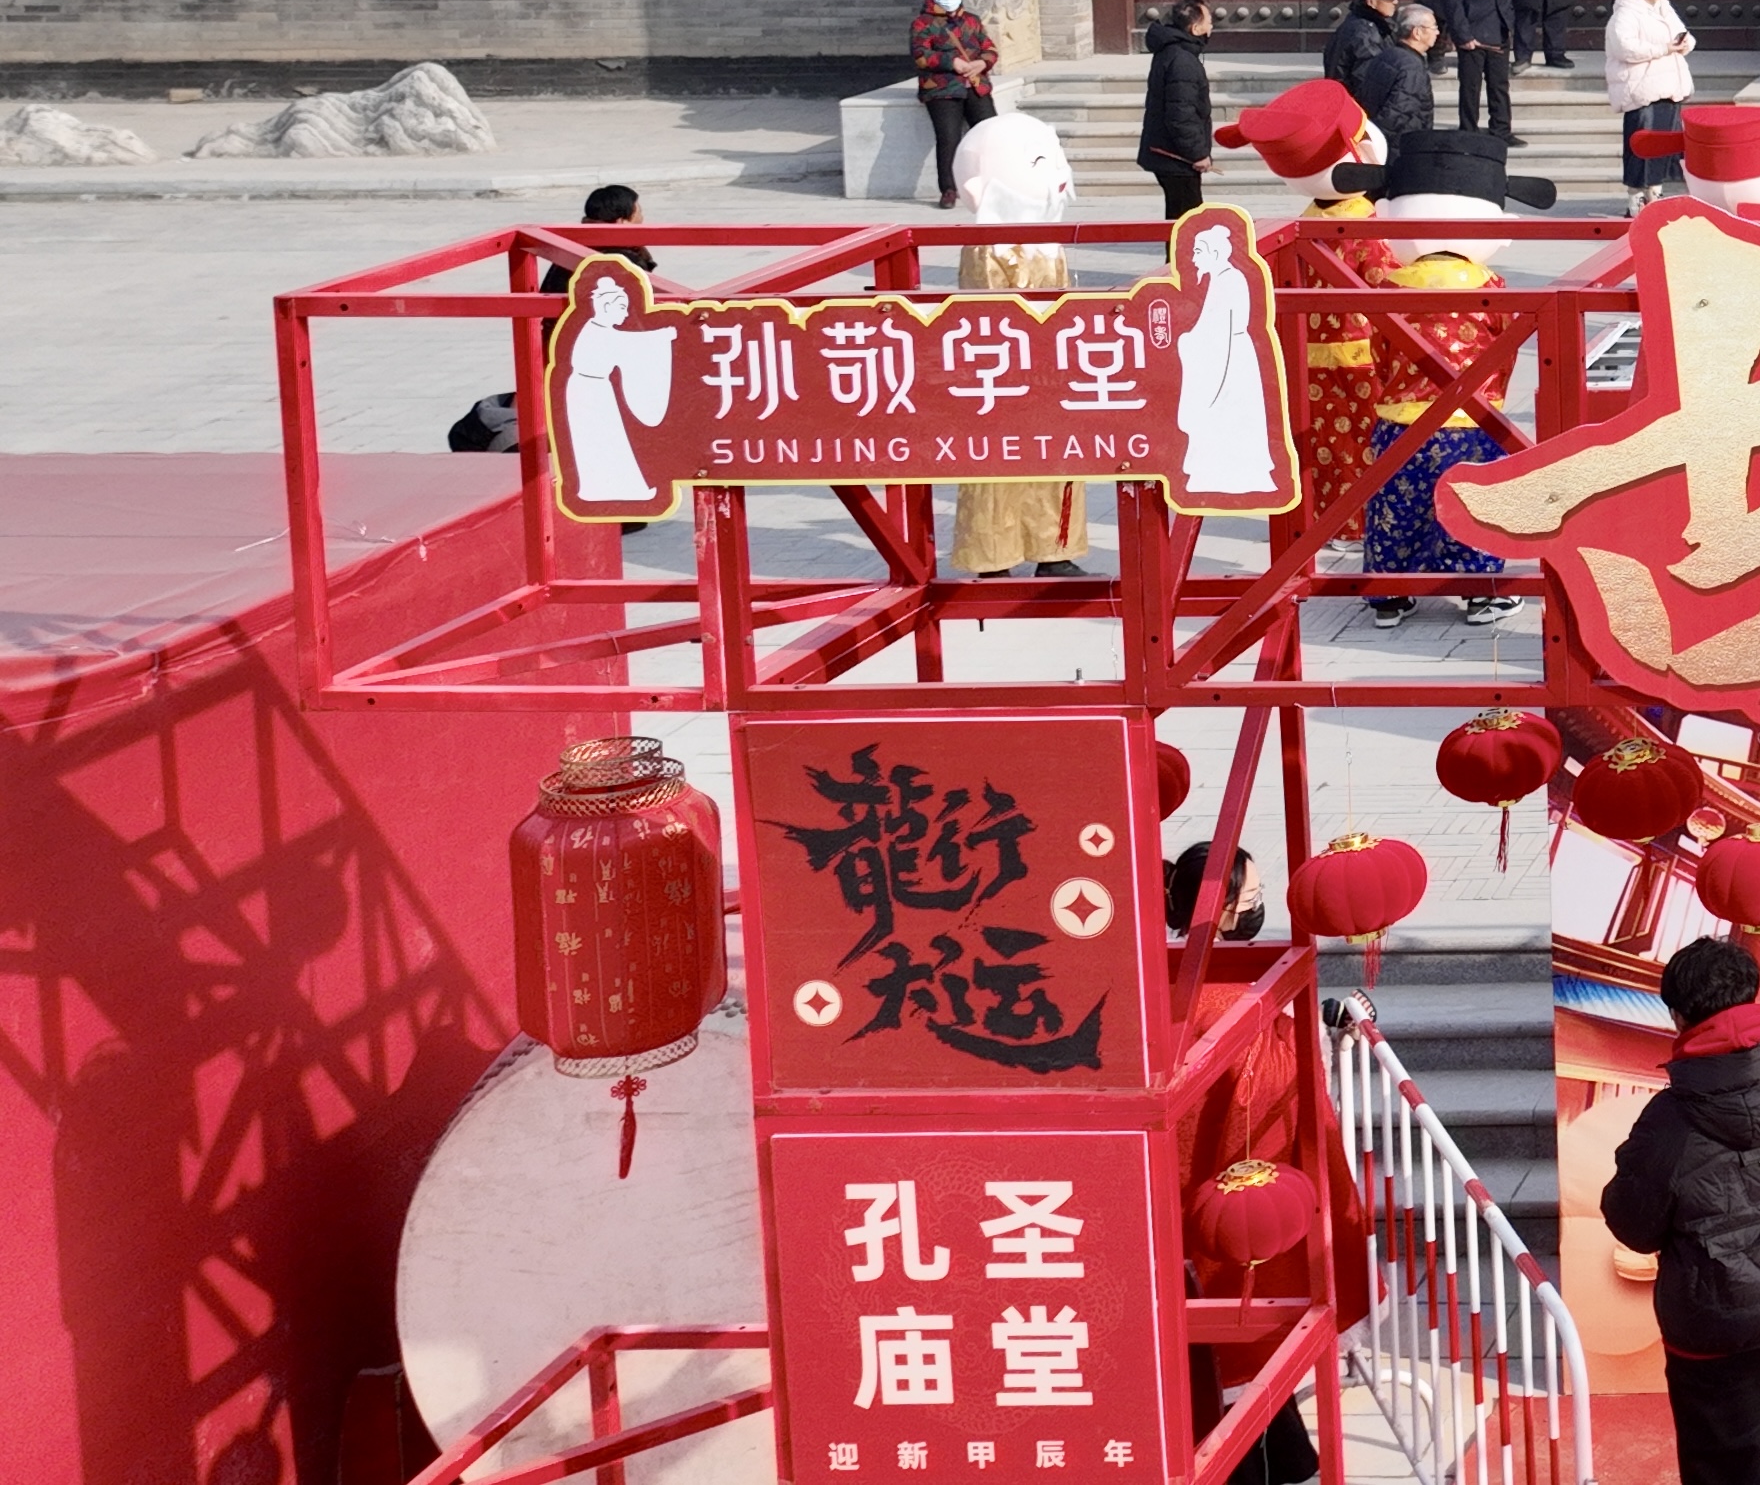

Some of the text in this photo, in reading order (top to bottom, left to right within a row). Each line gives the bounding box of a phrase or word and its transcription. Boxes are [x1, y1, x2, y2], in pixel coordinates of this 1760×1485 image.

[700, 317, 1147, 420] 孙敬学堂
[711, 433, 1150, 464] SUNJING XUETANG
[828, 1438, 1136, 1471] 迎新甲辰年
